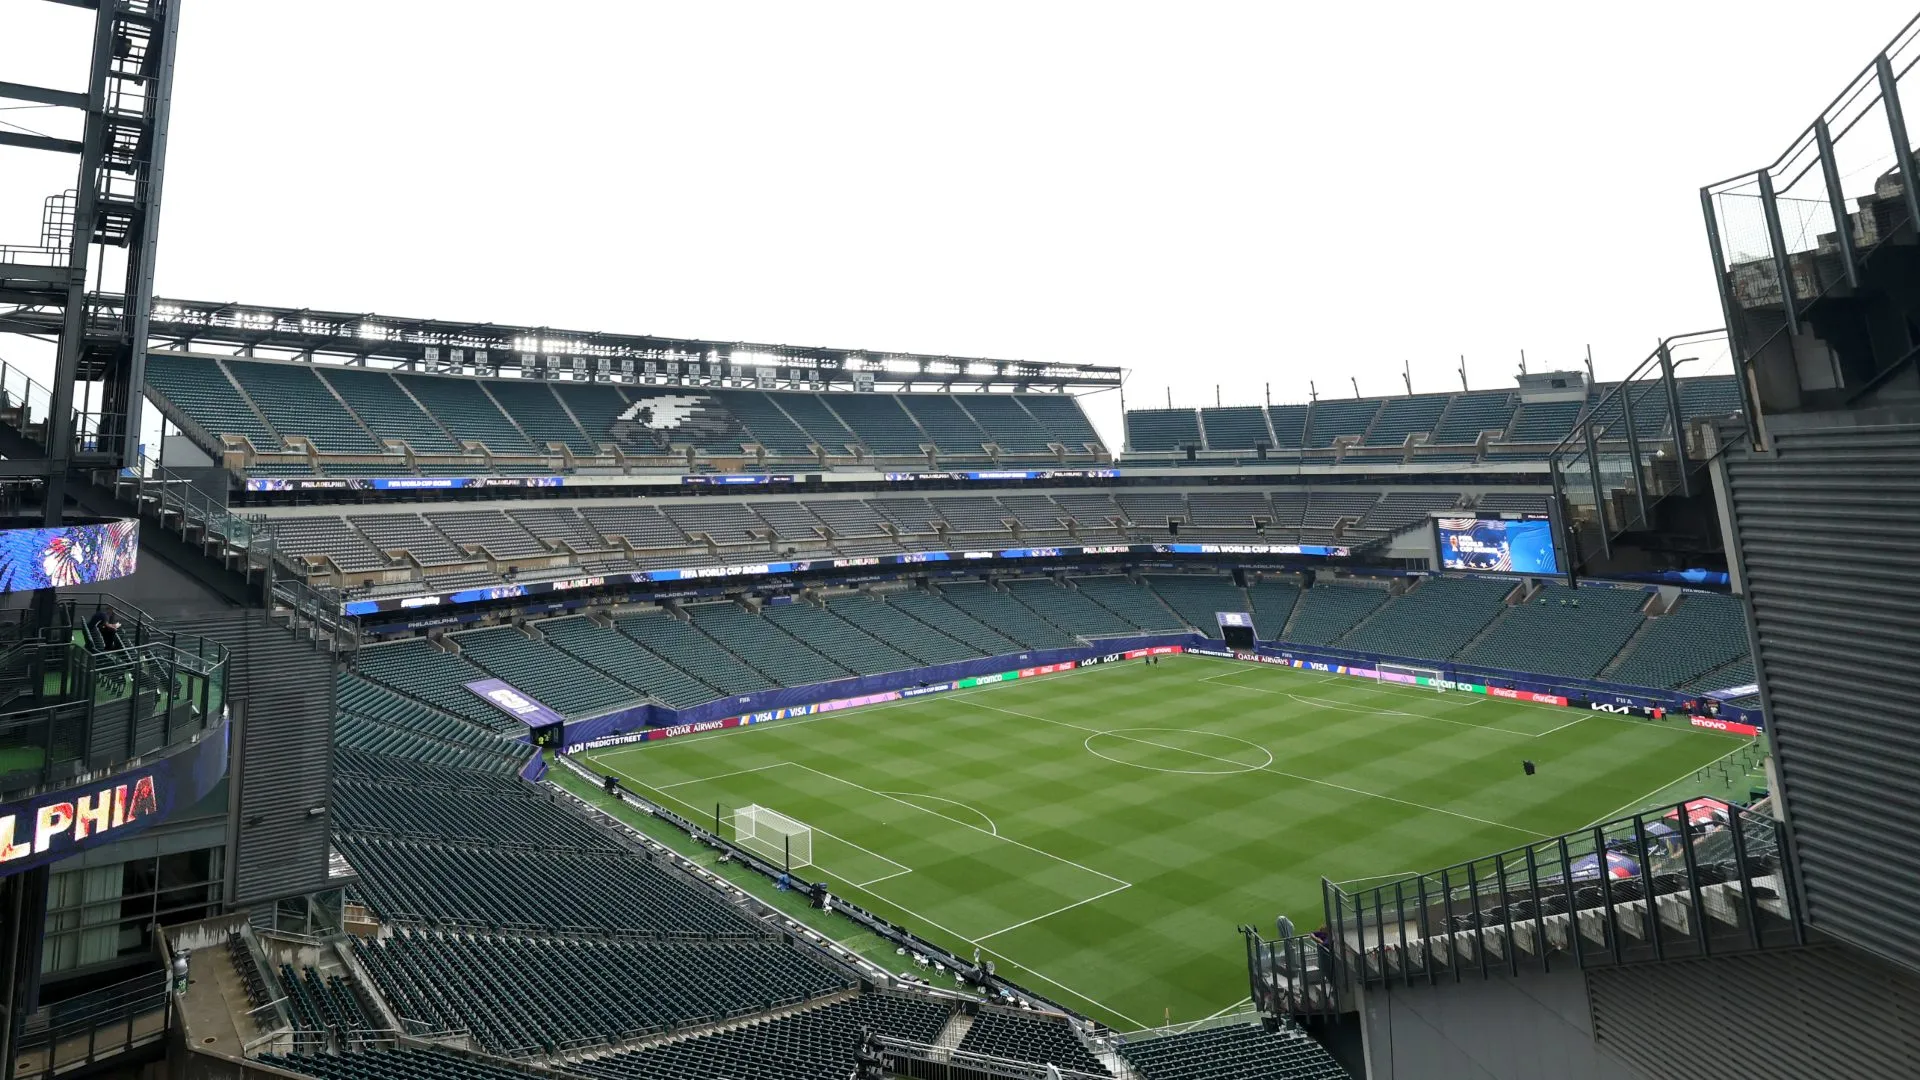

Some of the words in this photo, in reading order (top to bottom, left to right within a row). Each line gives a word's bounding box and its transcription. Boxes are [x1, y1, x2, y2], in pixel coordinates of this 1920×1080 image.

[1082, 546, 1130, 554] PHILADELPHIA
[1201, 545, 1220, 553] FIFA
[1220, 545, 1251, 553] WORLD
[1251, 545, 1270, 553] CUP
[833, 557, 880, 568] PHILADELPHIA
[680, 569, 698, 579] FIFA
[698, 567, 727, 578] WORLD
[726, 566, 743, 576] CUP
[552, 577, 605, 591] PHILADELPHIA
[654, 590, 698, 599] PHILADELPHIA
[407, 617, 459, 628] PHILADELPHIA
[1238, 653, 1259, 662] QATAR
[1261, 655, 1289, 666] AIRWAYS
[1310, 662, 1329, 671] VISA
[976, 673, 1003, 685] aramco
[1428, 678, 1472, 691] aramco
[1615, 696, 1633, 705] FIFA
[788, 706, 807, 716] VISA
[1591, 702, 1629, 714] KIA
[754, 713, 773, 723] VISA
[665, 724, 691, 737] QATAR
[693, 720, 723, 732] AIRWAYS
[567, 741, 585, 755] ADI
[585, 734, 642, 749] PREDICTSTREET
